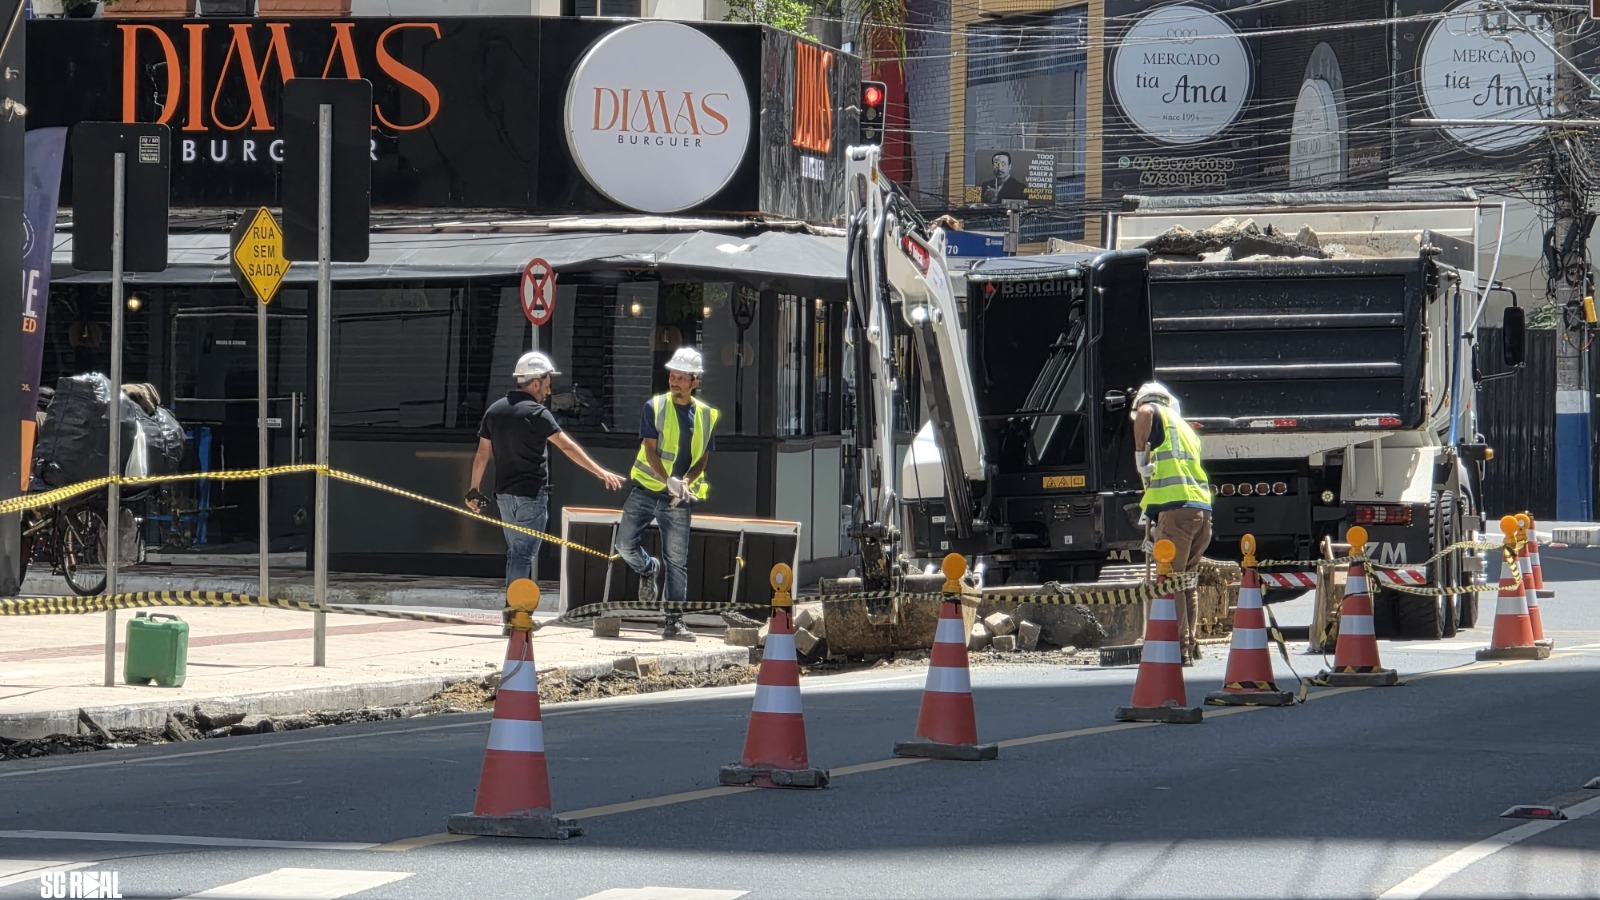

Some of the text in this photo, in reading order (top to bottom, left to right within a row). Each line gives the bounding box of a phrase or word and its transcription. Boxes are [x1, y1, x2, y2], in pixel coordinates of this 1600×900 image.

[1143, 52, 1220, 66] MERCADO
[1453, 49, 1536, 63] MERCADO
[1136, 72, 1227, 103] tia Ana
[1445, 71, 1544, 106] tia Ana
[591, 87, 729, 135] DIMAS
[1162, 113, 1180, 121] since
[618, 134, 702, 148] BURGUER
[182, 139, 378, 161] BURGR
[253, 226, 275, 239] RUA
[253, 245, 275, 258] SEM
[946, 245, 959, 255] 70
[248, 260, 281, 277] SAÍDA
